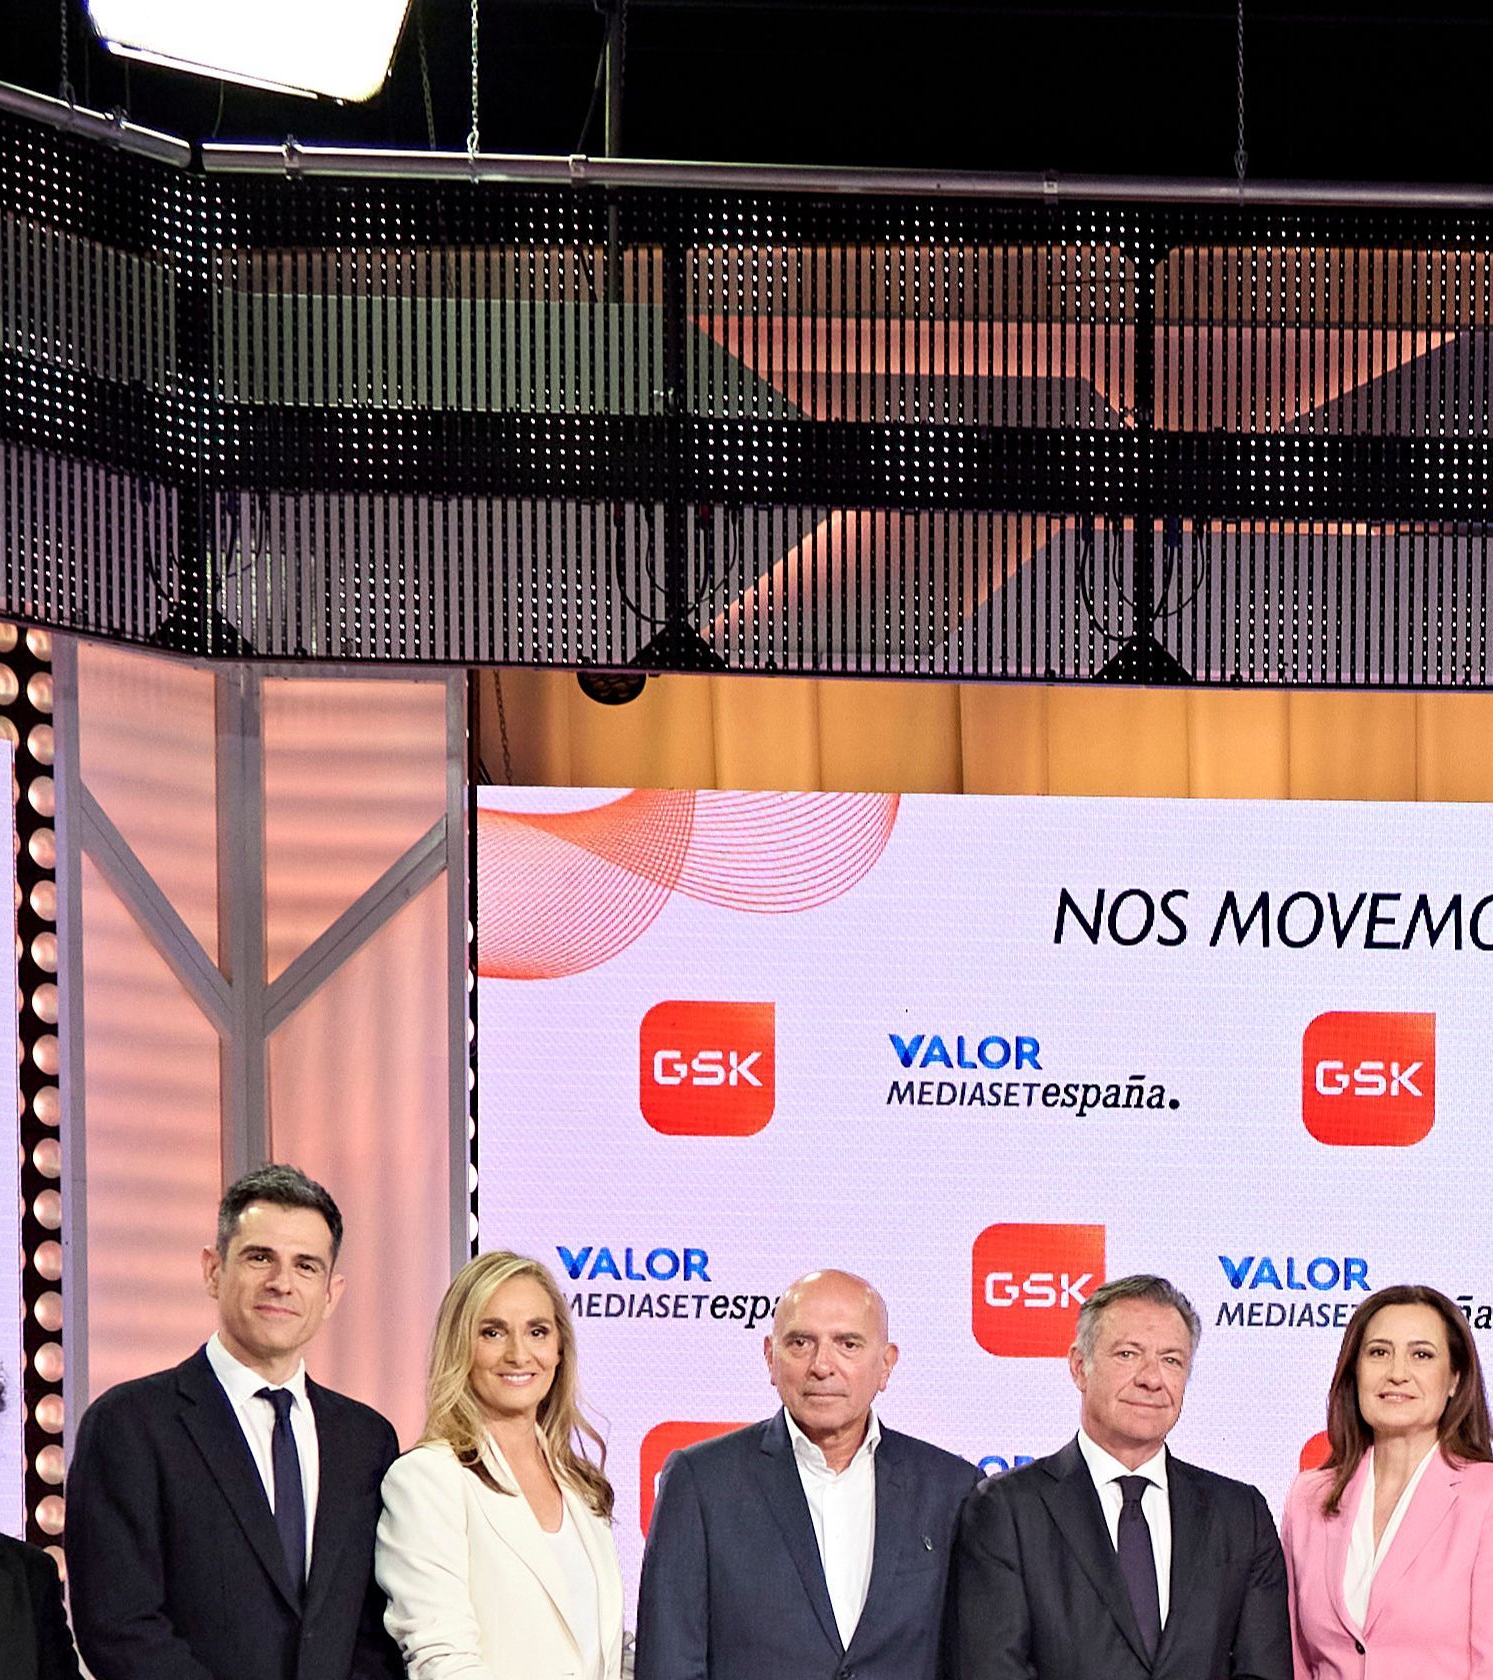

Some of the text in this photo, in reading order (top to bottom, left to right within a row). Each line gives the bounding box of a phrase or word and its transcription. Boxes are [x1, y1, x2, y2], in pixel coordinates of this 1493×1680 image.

[1053, 887, 1189, 947] NOS
[653, 1050, 763, 1088] GSK
[888, 1033, 1043, 1071] VALOR
[1315, 1060, 1423, 1098] GSK
[555, 1245, 712, 1283] VALOR
[1217, 1255, 1372, 1292] VALOR
[985, 1272, 1093, 1308] GSK
